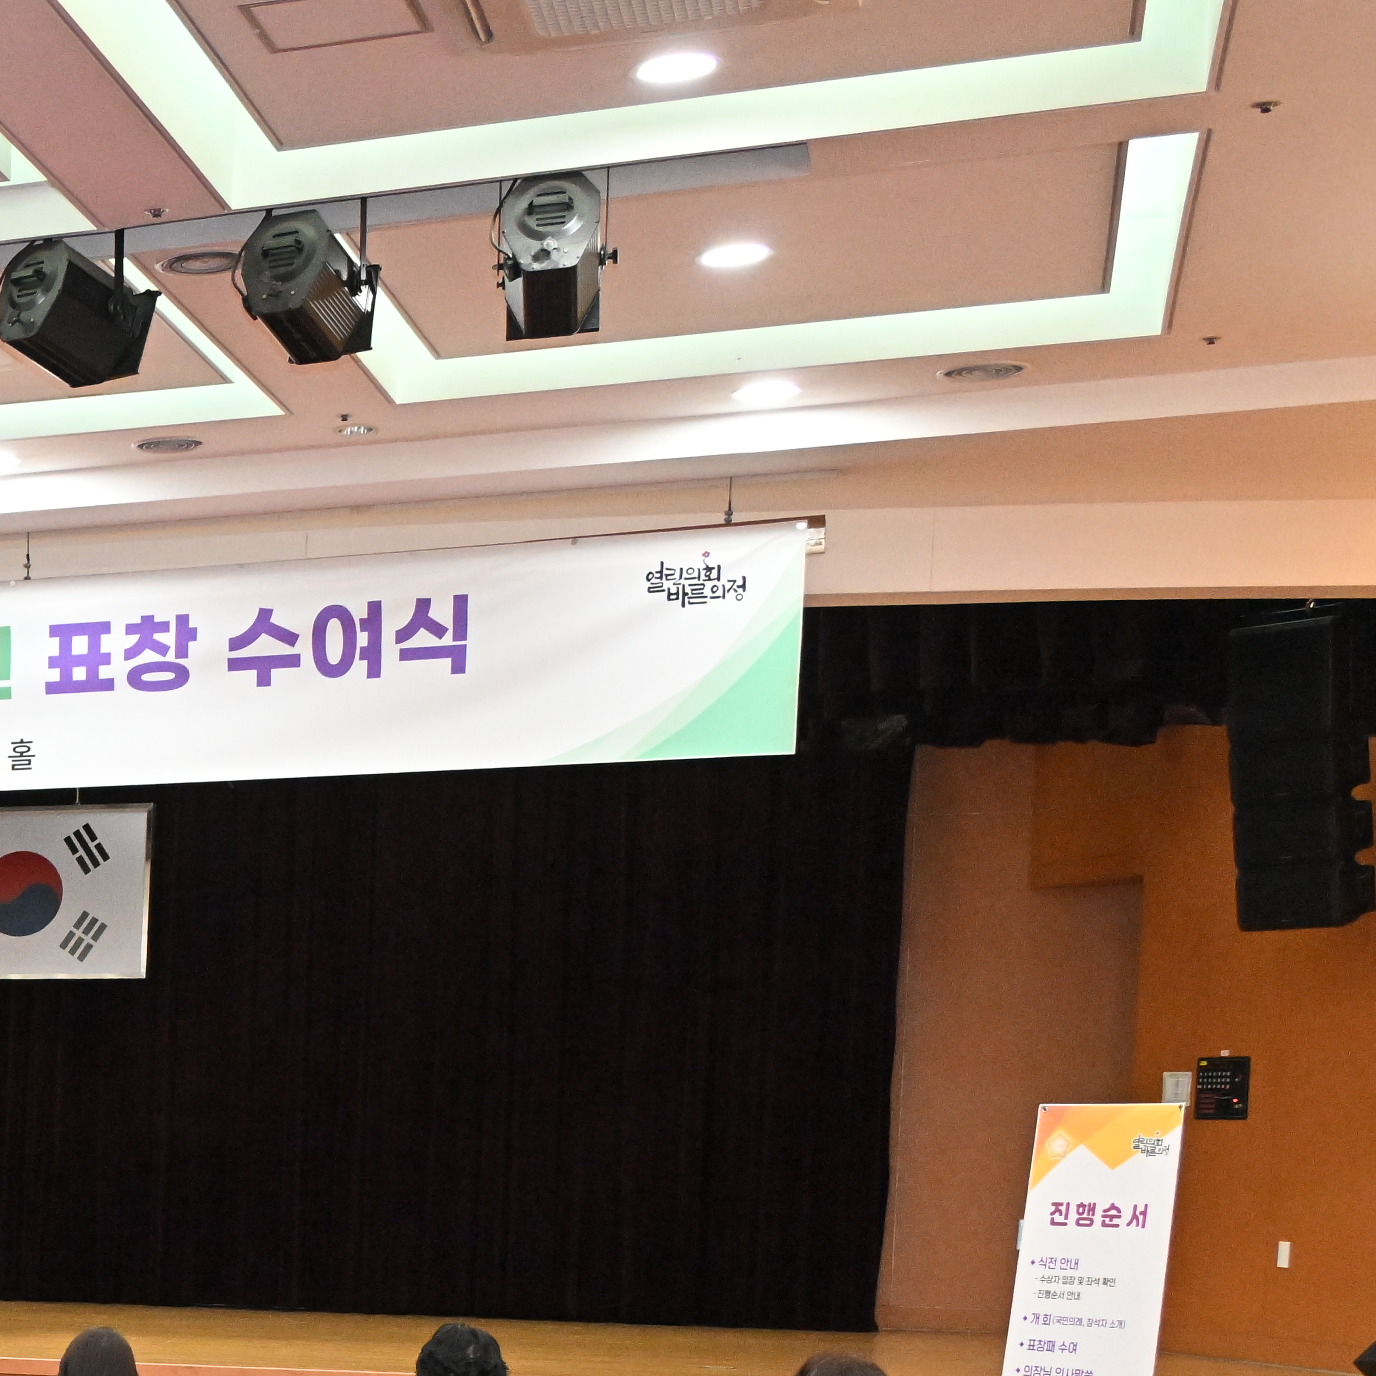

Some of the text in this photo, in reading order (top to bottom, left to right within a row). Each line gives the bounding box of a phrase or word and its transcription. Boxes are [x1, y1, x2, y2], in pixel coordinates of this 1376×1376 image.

[646, 561, 721, 593] 열린의회
[667, 576, 747, 608] 바른의정
[45, 613, 198, 695] 표창
[227, 594, 469, 687] 수여식
[1049, 1201, 1149, 1229] 진행순서
[1038, 1257, 1080, 1270] 식전 안내
[1026, 1338, 1078, 1354] 표창패 수여
